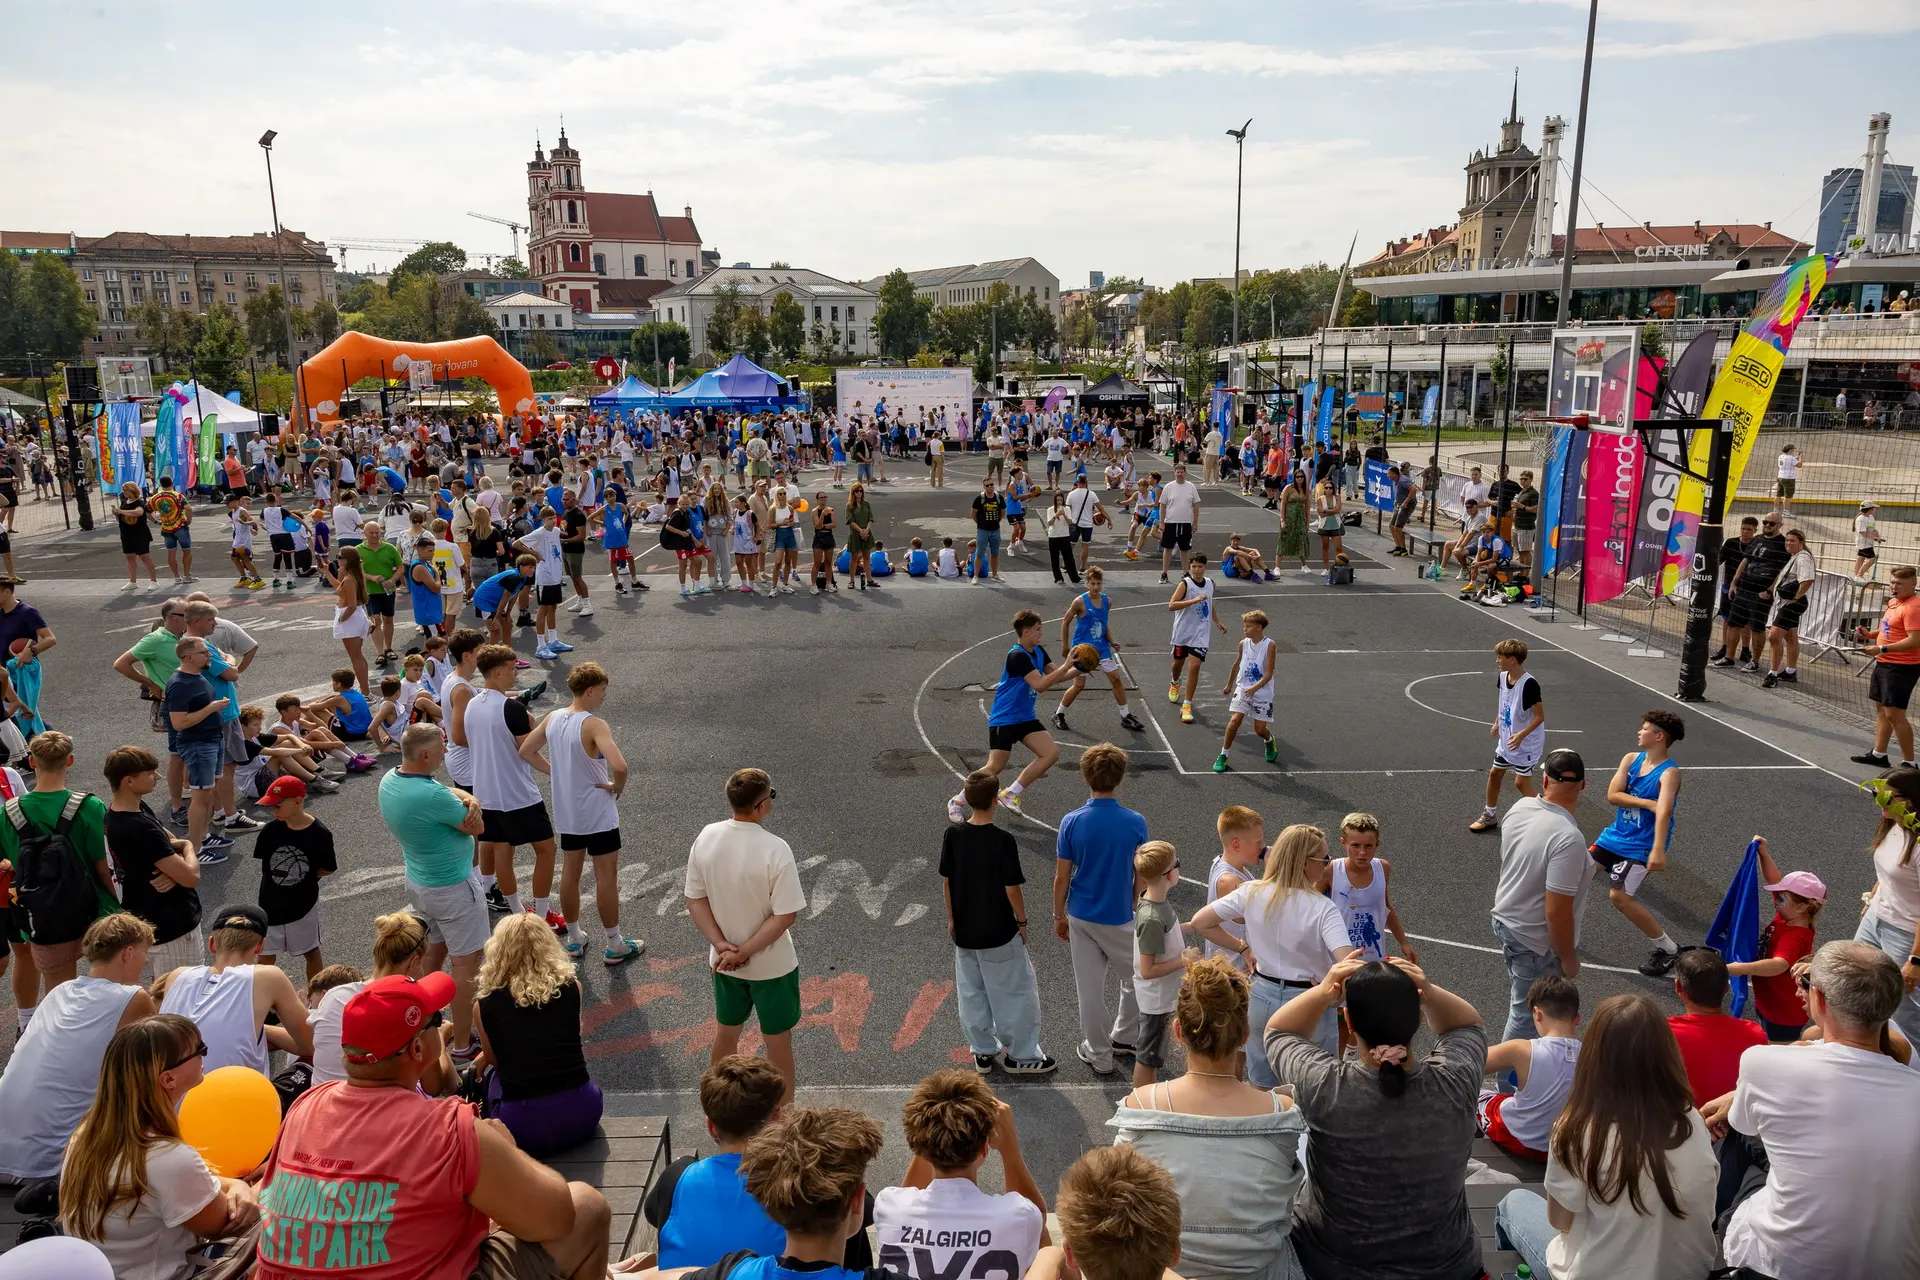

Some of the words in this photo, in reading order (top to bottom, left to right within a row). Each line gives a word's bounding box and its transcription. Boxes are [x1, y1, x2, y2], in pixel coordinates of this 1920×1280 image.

[1634, 244, 1710, 257] CAFFEINE
[1739, 359, 1769, 384] 360
[1734, 377, 1762, 395] arena
[320, 1158, 336, 1168] NEW
[335, 1160, 355, 1170] YORK
[307, 1222, 393, 1269] PARK
[901, 1225, 992, 1248] ŽALGIRIO
